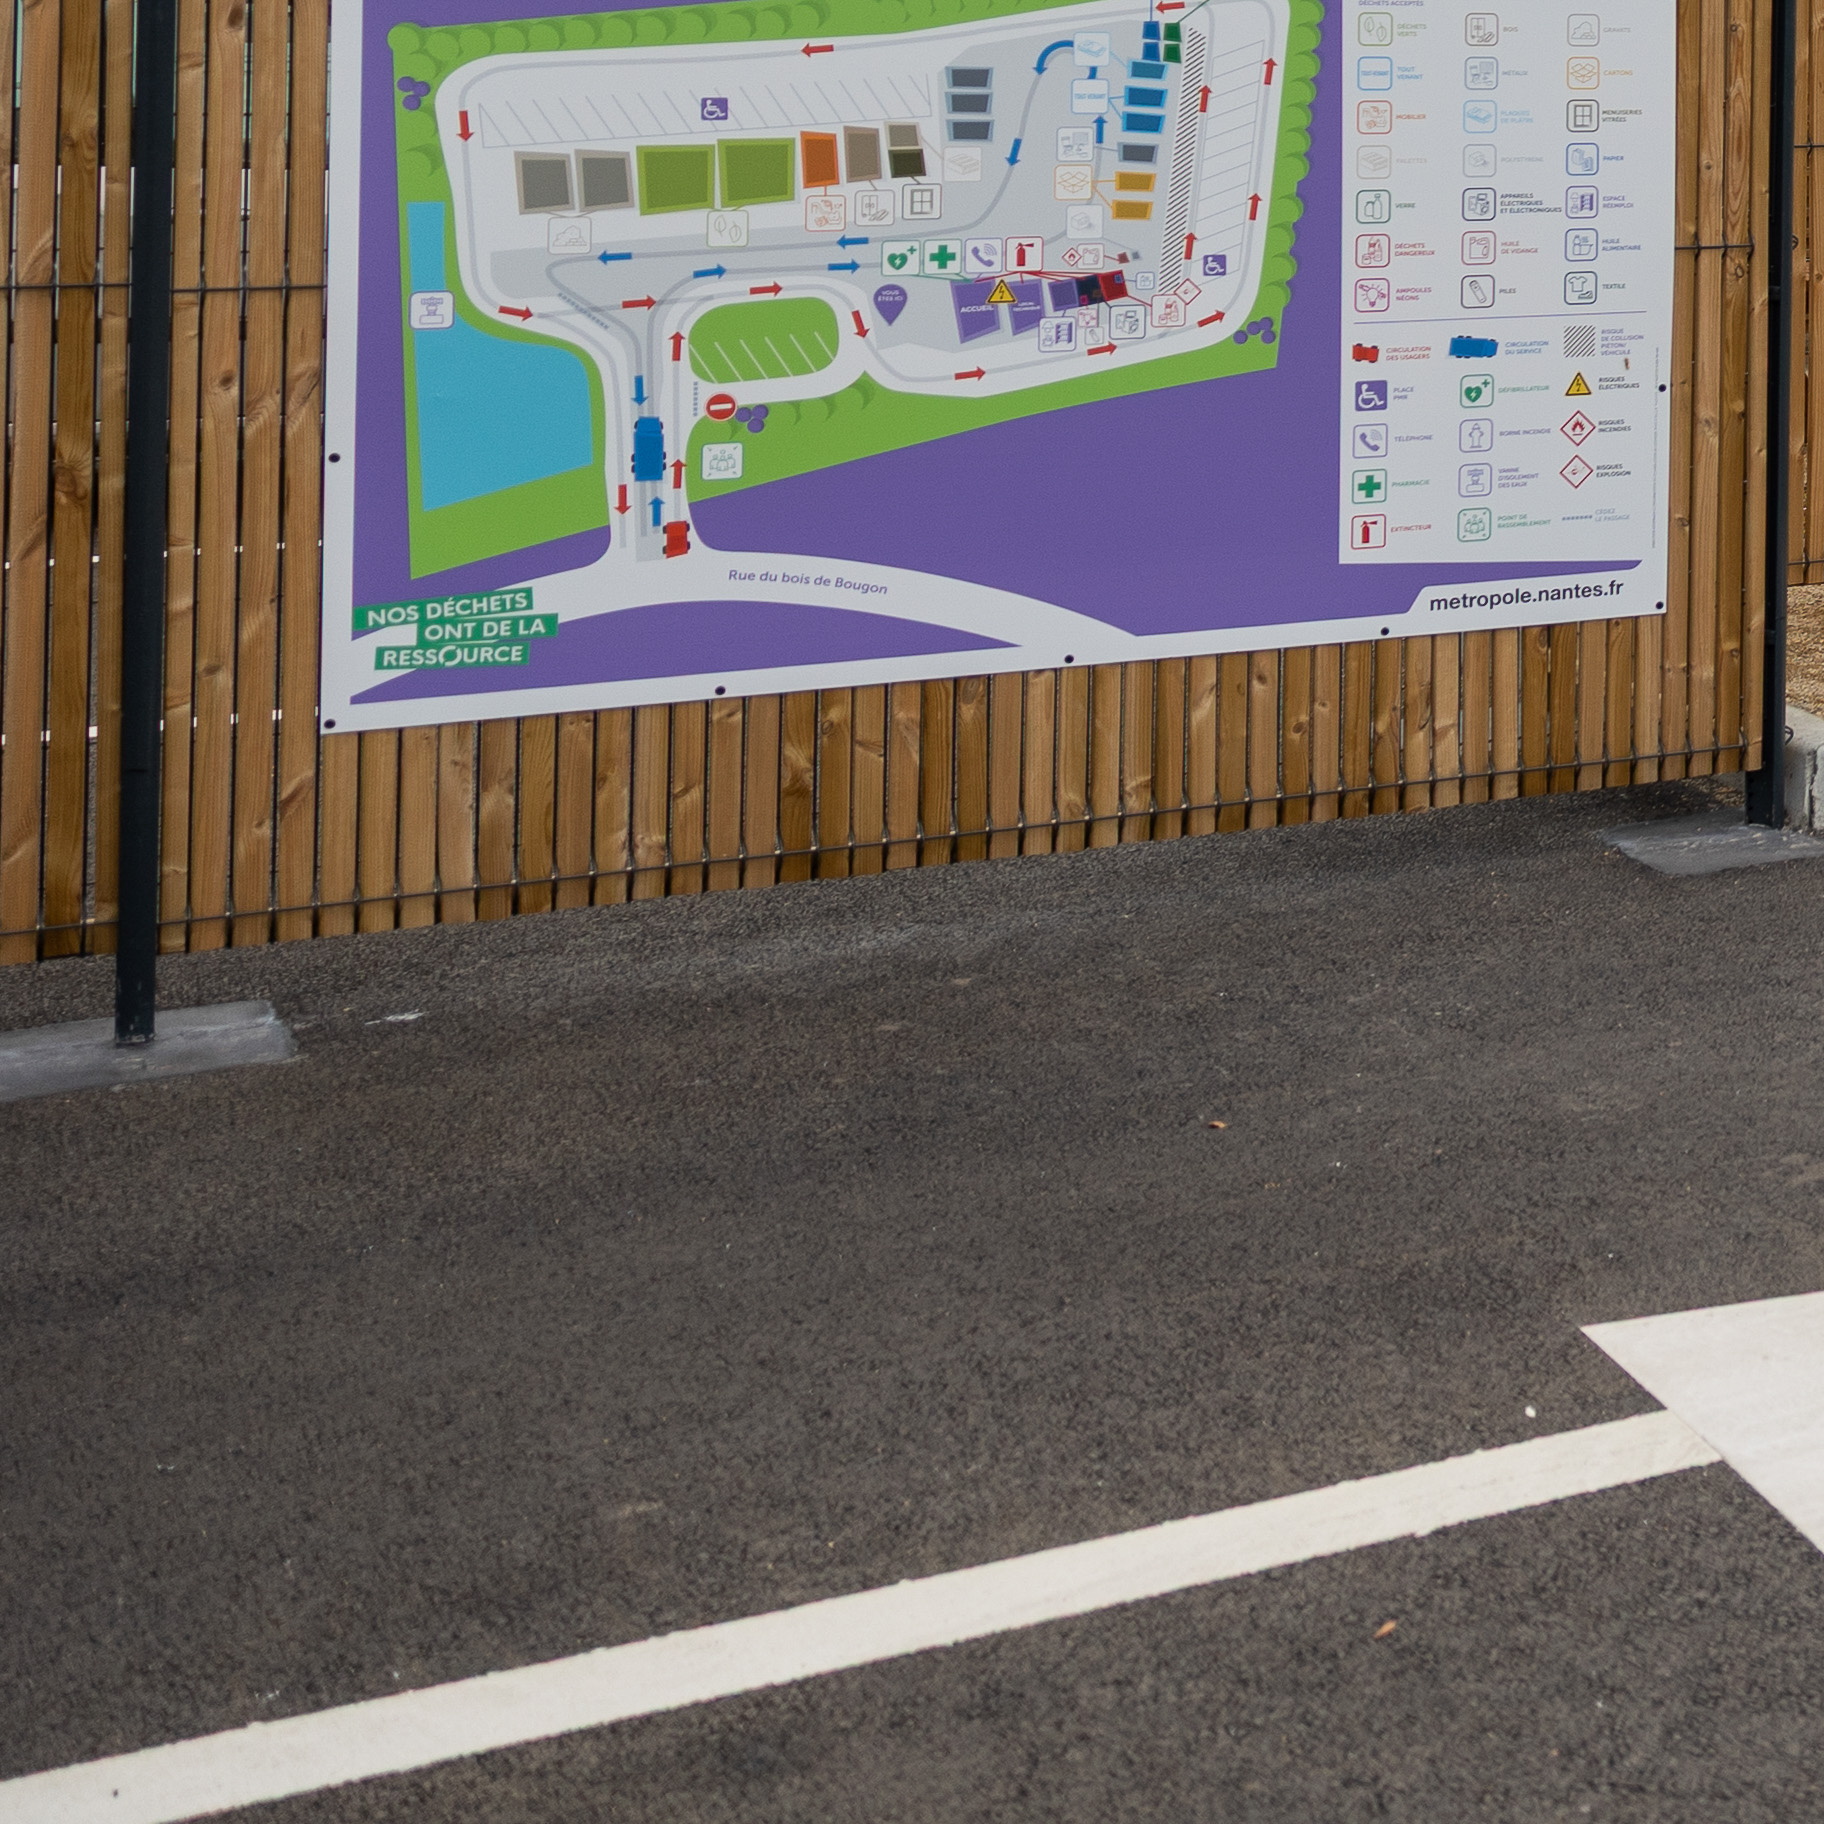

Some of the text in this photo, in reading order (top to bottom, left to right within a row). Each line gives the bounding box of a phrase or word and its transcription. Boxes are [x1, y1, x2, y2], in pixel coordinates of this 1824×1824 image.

[1394, 249, 1435, 257] DANGEREUX
[960, 305, 994, 313] ACCUEIL
[1505, 340, 1549, 348] CIRCULATION
[1386, 346, 1432, 354] CIRCULATION
[1598, 418, 1625, 426] RISQUES
[1598, 425, 1632, 433] INCENDIES
[1596, 470, 1631, 478] EXPLOSION
[1391, 525, 1432, 533] EXTINCTEUR
[728, 569, 888, 595] Rue du bois de Bougon
[1429, 580, 1624, 612] metropole.nantes.fr
[367, 592, 528, 627] NOS DÉCHETS
[424, 618, 546, 641] ONT DE LA
[383, 645, 524, 667] RESSOURCE
